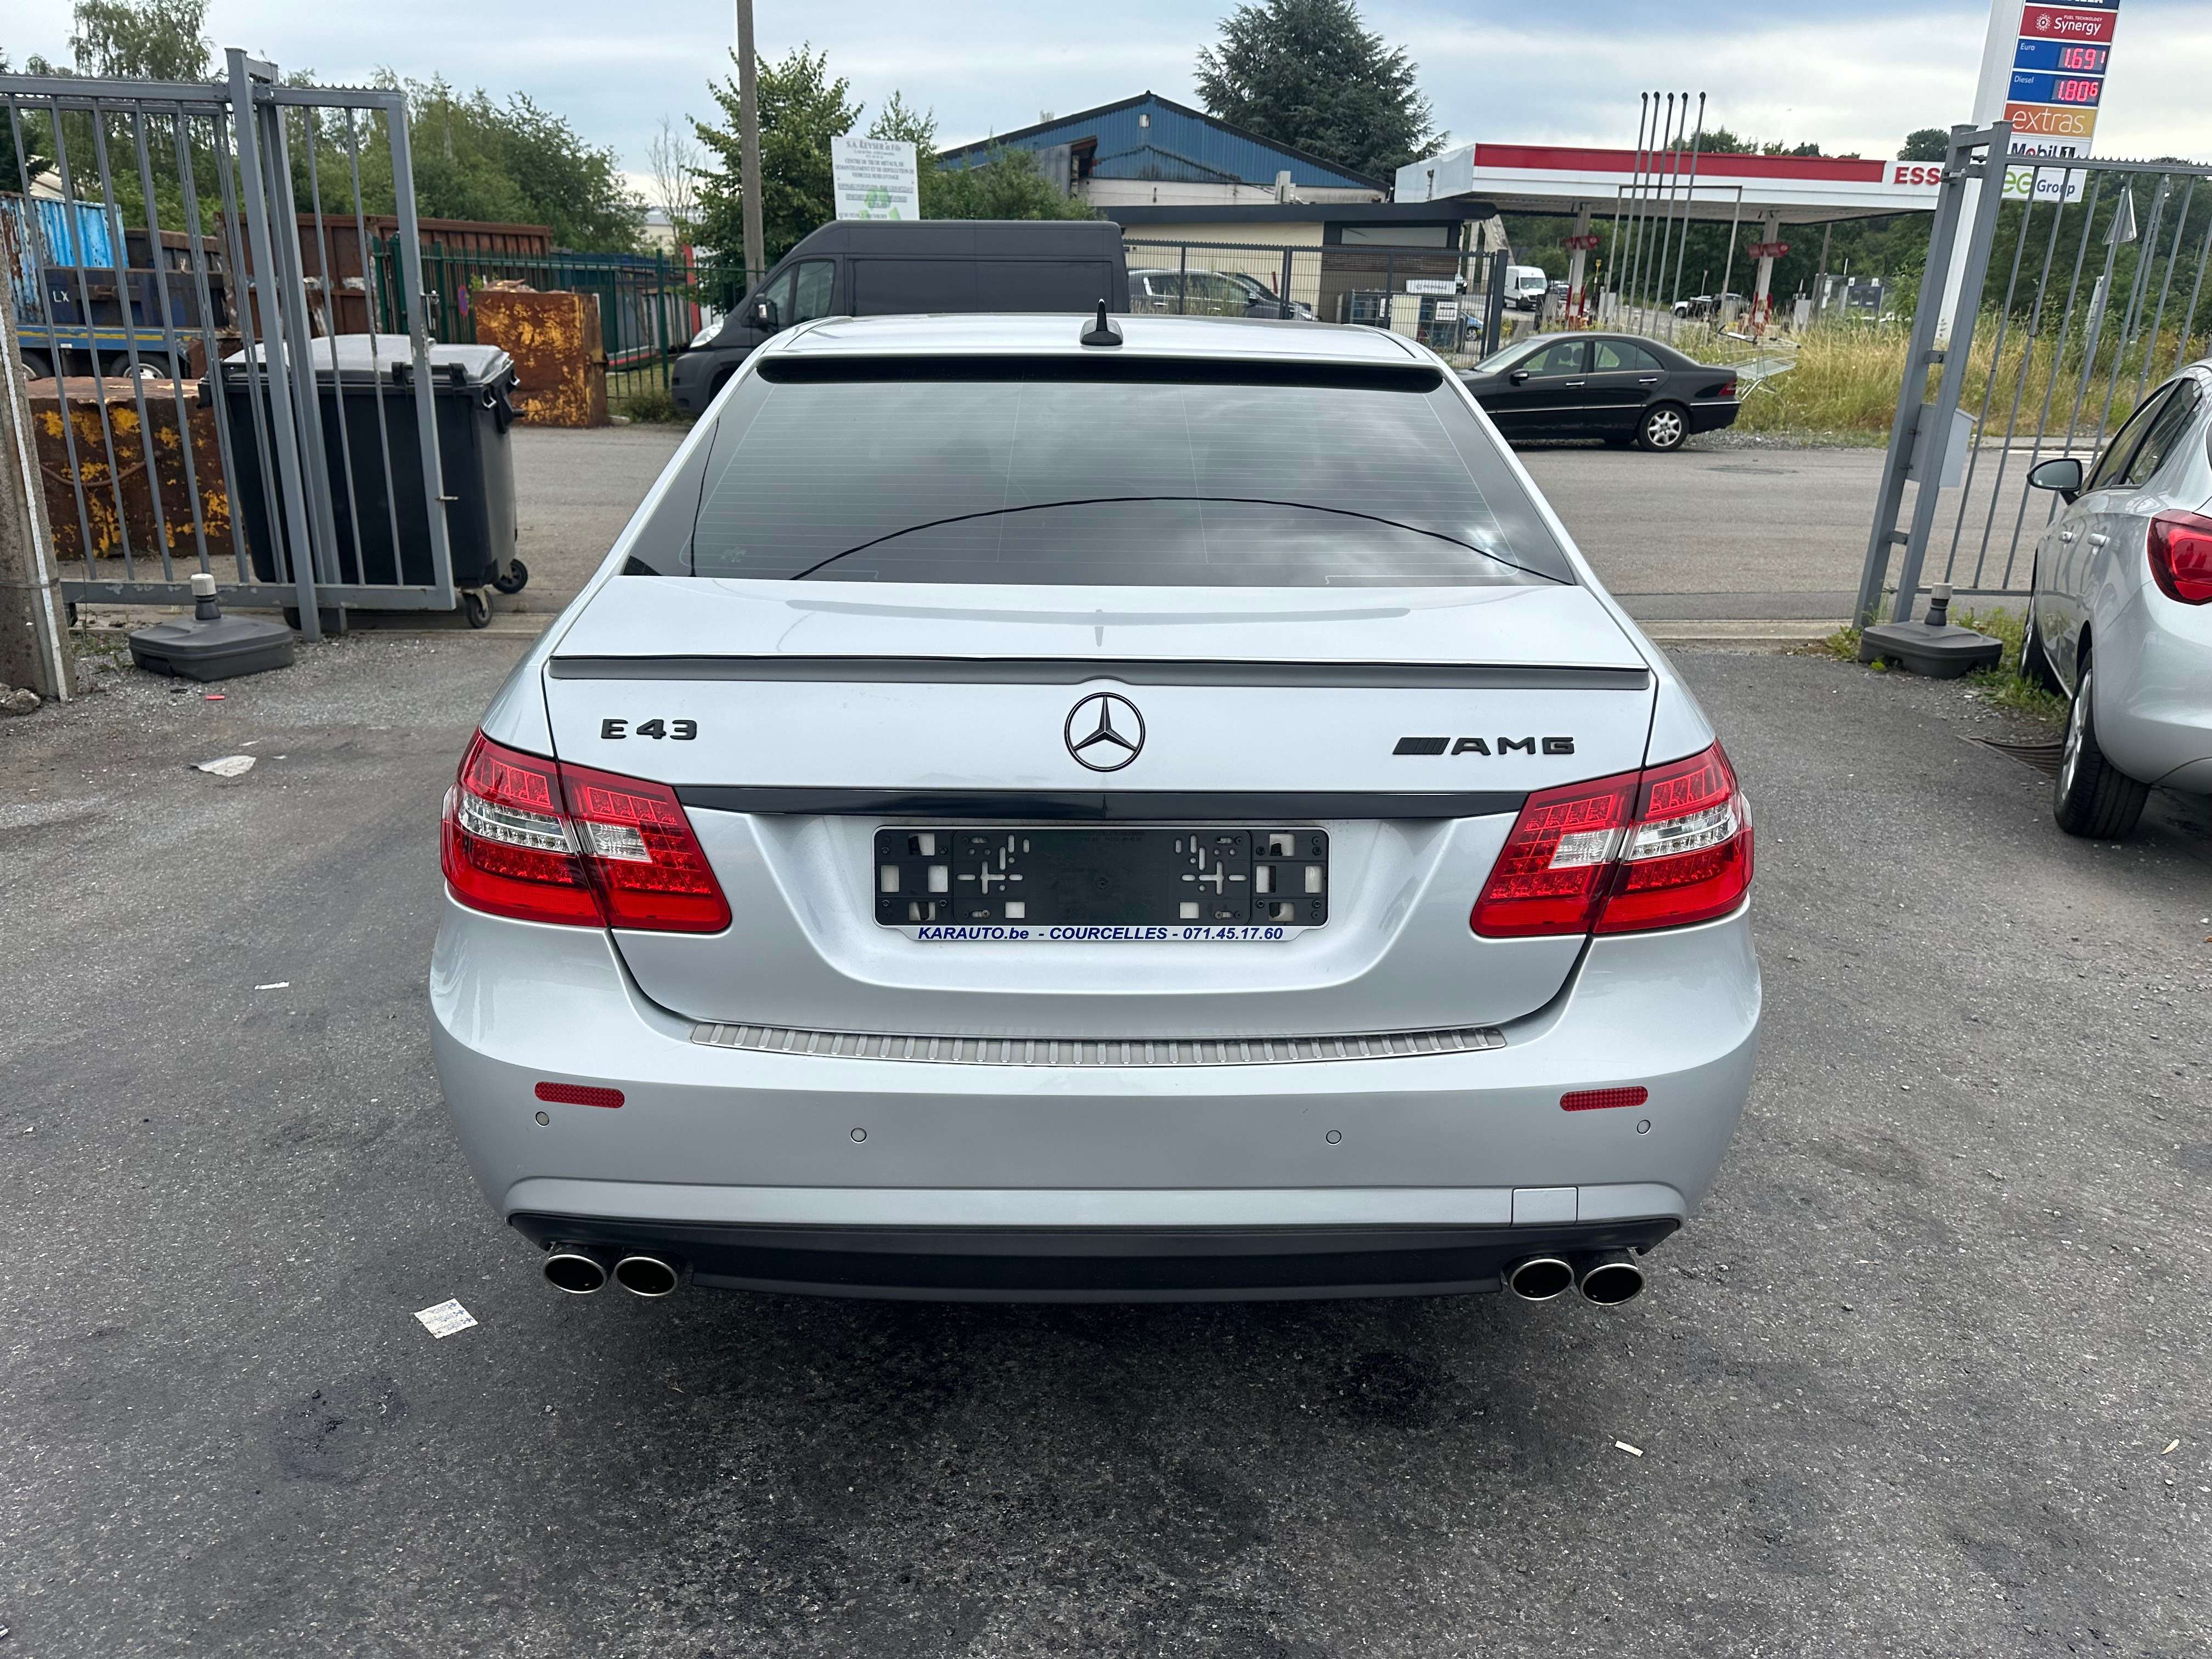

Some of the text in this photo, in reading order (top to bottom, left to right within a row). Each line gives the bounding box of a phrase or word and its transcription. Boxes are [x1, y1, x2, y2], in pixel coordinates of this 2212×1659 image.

[2054, 17, 2102, 36] Synergy
[2020, 43, 2035, 51] Euro
[2014, 75, 2034, 84] Diesel
[2012, 108, 2085, 133] extras
[2011, 143, 2057, 158] Mobil
[1894, 166, 1940, 185] ESS
[2036, 179, 2075, 197] Grop
[601, 719, 697, 740] E 43
[1451, 737, 1575, 755] AMG
[918, 927, 1029, 939] KARAUTO.be
[1049, 927, 1168, 940] COURCELLES
[1183, 927, 1283, 940] 071.45.17.60
